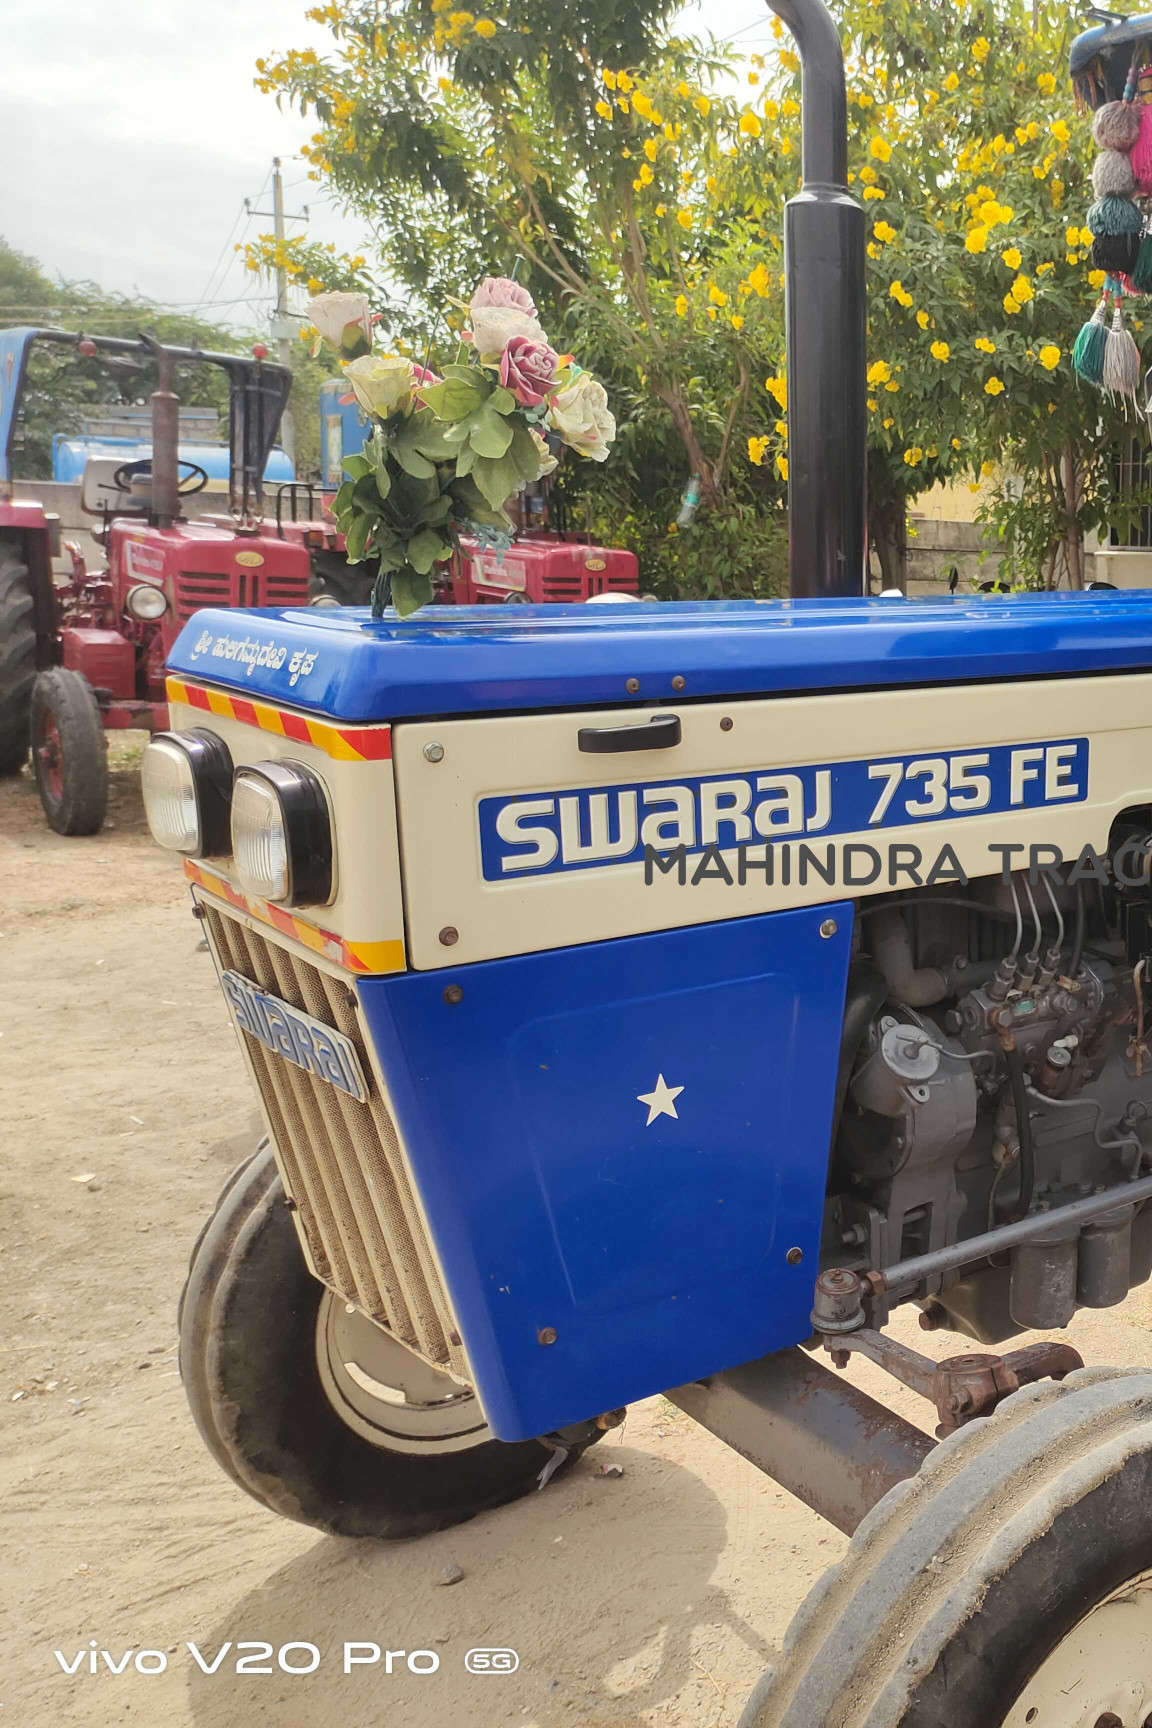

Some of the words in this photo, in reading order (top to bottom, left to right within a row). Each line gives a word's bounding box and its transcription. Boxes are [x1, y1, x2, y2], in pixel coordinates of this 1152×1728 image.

[190, 630, 213, 661] ಶ್ರೀ
[868, 753, 992, 826] 735
[1010, 744, 1081, 806] FE
